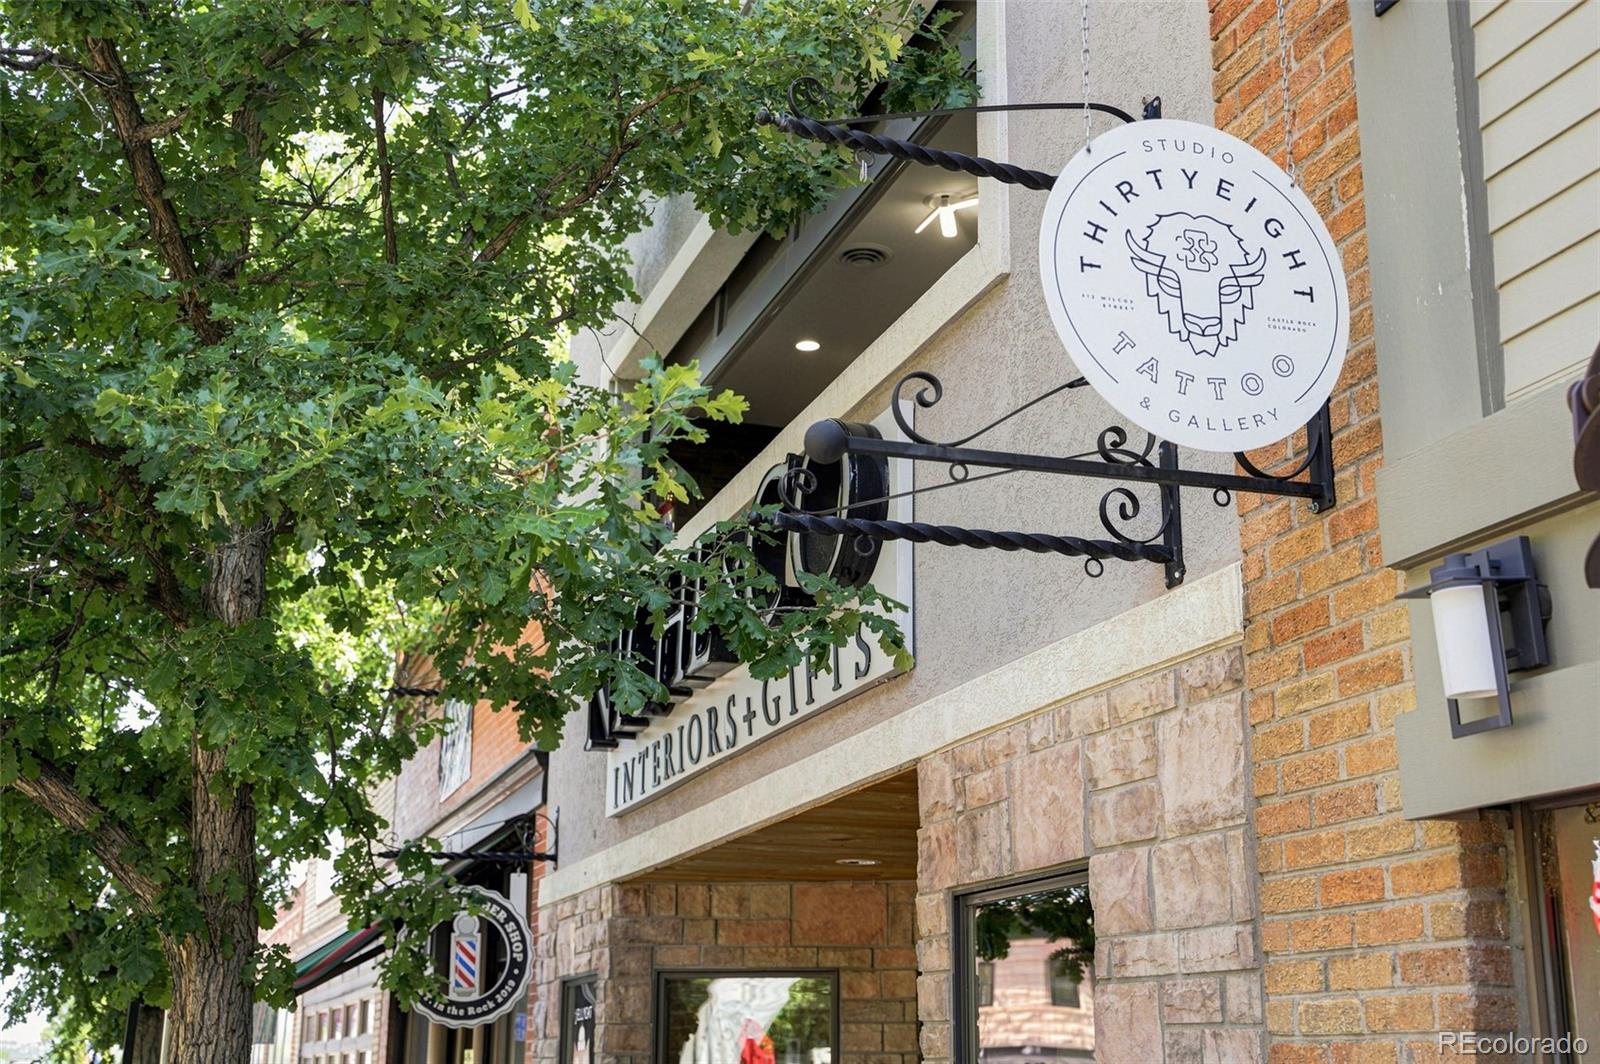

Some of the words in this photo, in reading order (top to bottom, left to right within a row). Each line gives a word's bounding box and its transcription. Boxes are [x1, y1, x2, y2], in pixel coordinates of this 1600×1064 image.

[1142, 138, 1235, 165] STUDIO
[1080, 168, 1315, 303] THIRTYEIGHT
[1112, 331, 1295, 400] TATTOO
[1139, 397, 1152, 411] &
[1168, 408, 1280, 432] GALLERY
[504, 921, 523, 962] SHOP
[467, 1000, 496, 1016] Rock
